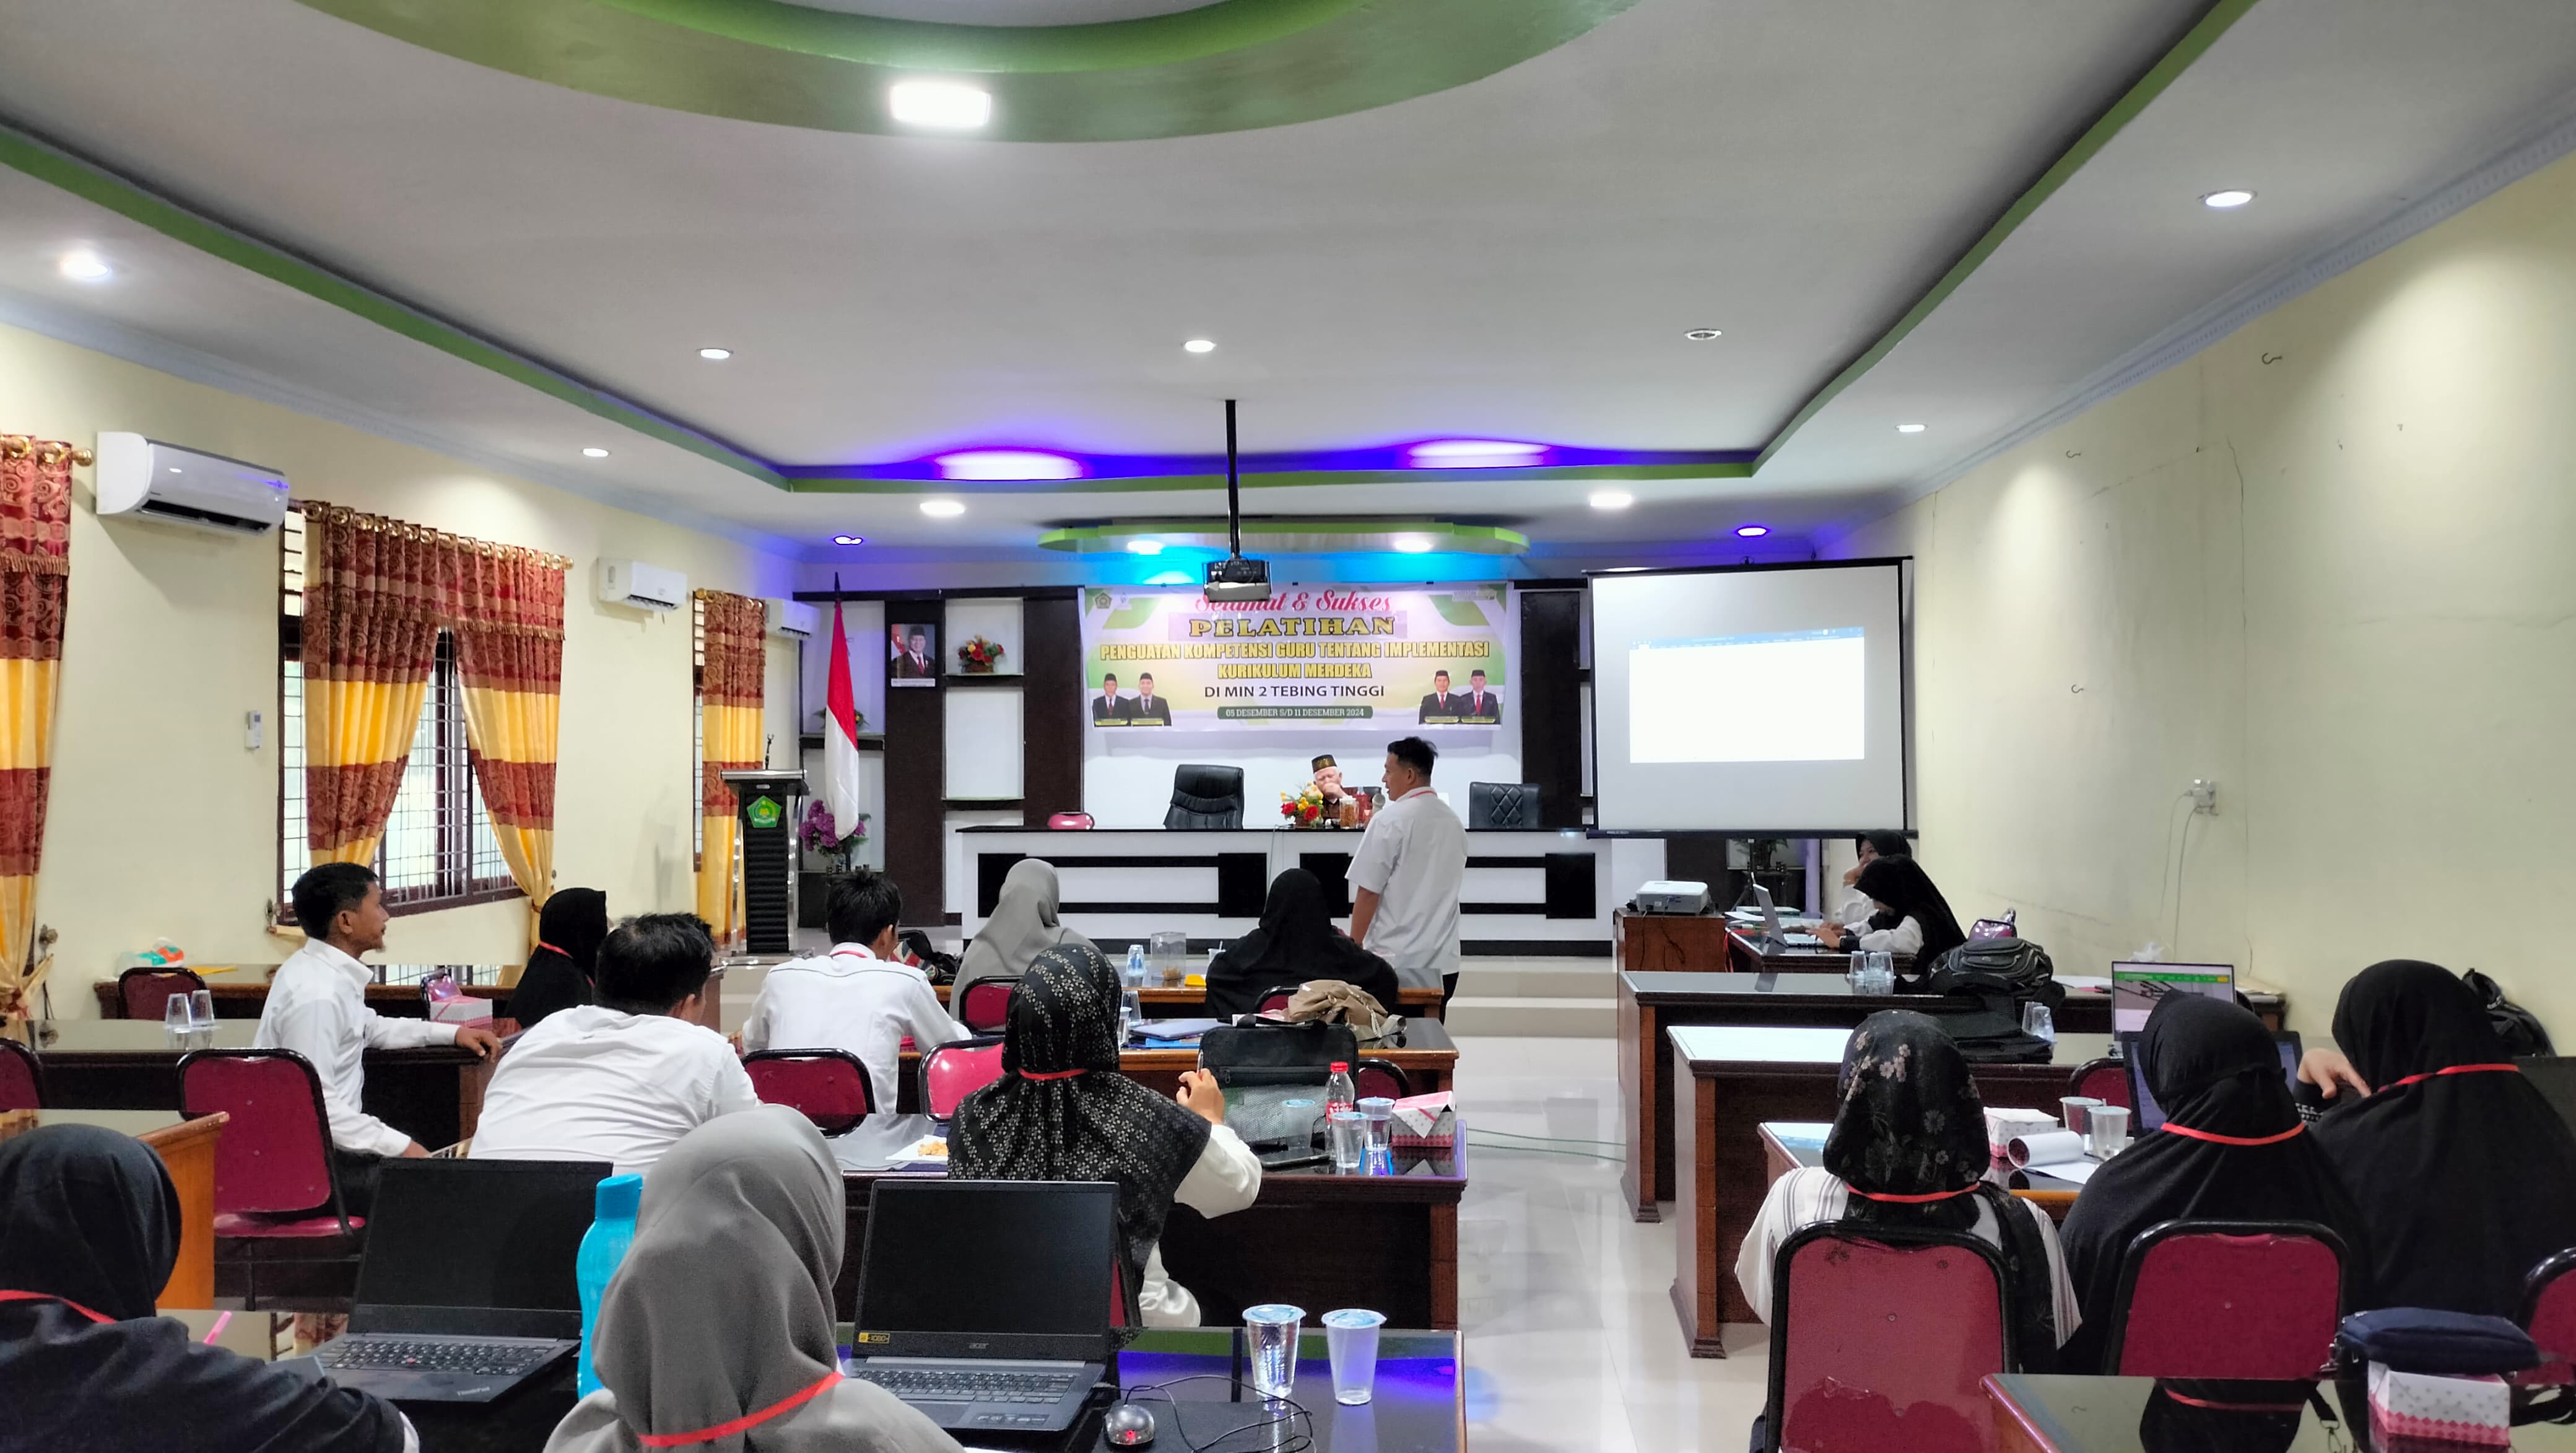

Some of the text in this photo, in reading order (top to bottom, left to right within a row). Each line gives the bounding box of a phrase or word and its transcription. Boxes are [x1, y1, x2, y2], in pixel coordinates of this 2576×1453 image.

[1292, 592, 1309, 611] &
[1315, 590, 1393, 611] Sukses
[1190, 617, 1395, 637] PELATIHAN
[1100, 640, 1489, 660] PENGUATAN KOMPETENSI GURU TENTANG IMPLEMENTASI
[1217, 663, 1373, 679] KURIKULUM MERDEKA
[1204, 685, 1385, 697] DI MIN 2 TEBING TINGGI
[1225, 709, 1235, 717] 05
[1302, 709, 1345, 717] DESEMBER
